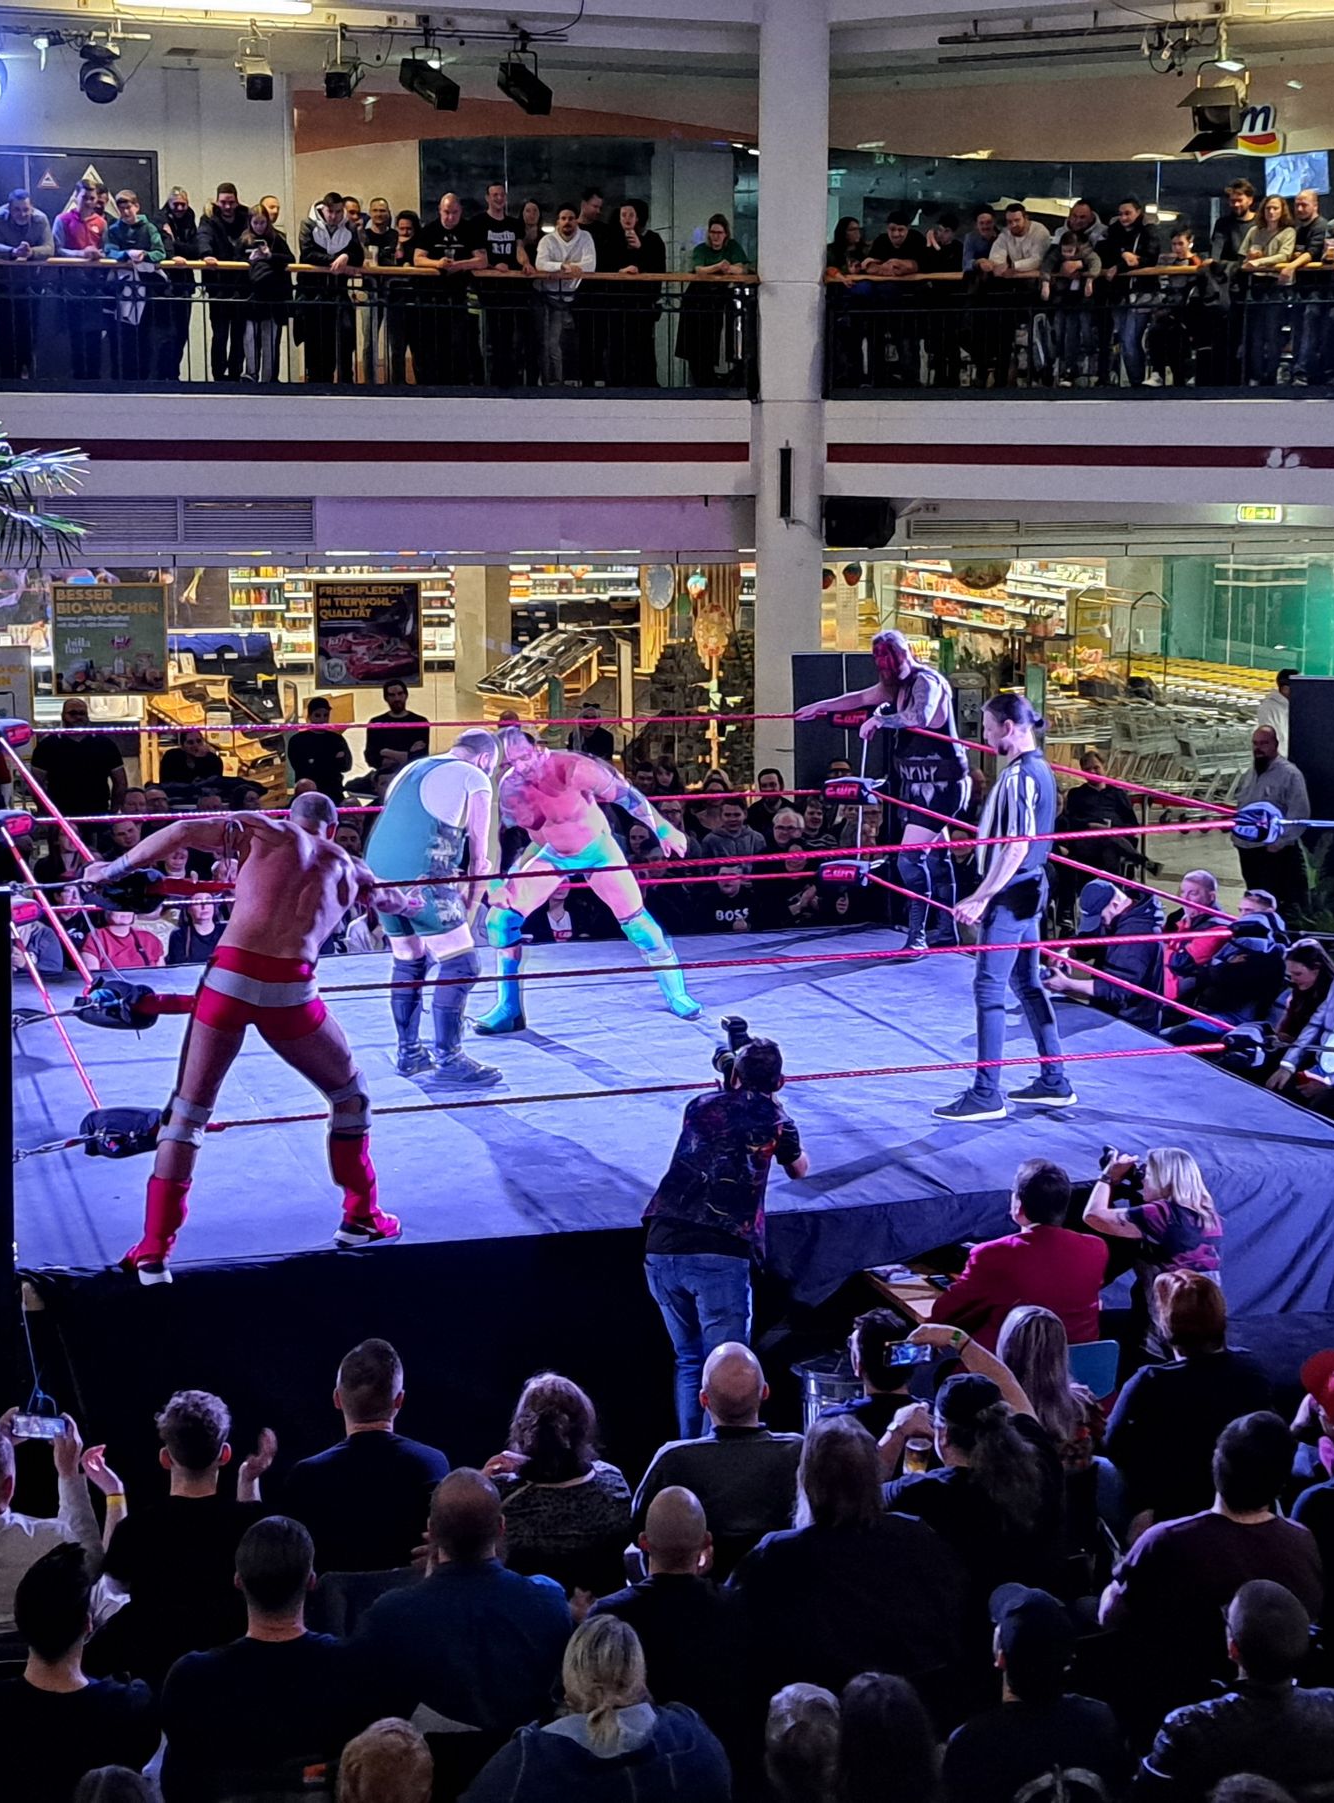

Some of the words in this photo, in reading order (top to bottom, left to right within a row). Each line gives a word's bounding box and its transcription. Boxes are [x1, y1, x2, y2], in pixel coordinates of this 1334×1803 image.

[56, 588, 113, 600] BESSER
[56, 602, 158, 614] BIO-WOCHEN
[319, 598, 332, 607] IN
[319, 607, 372, 619] QUALITÄT
